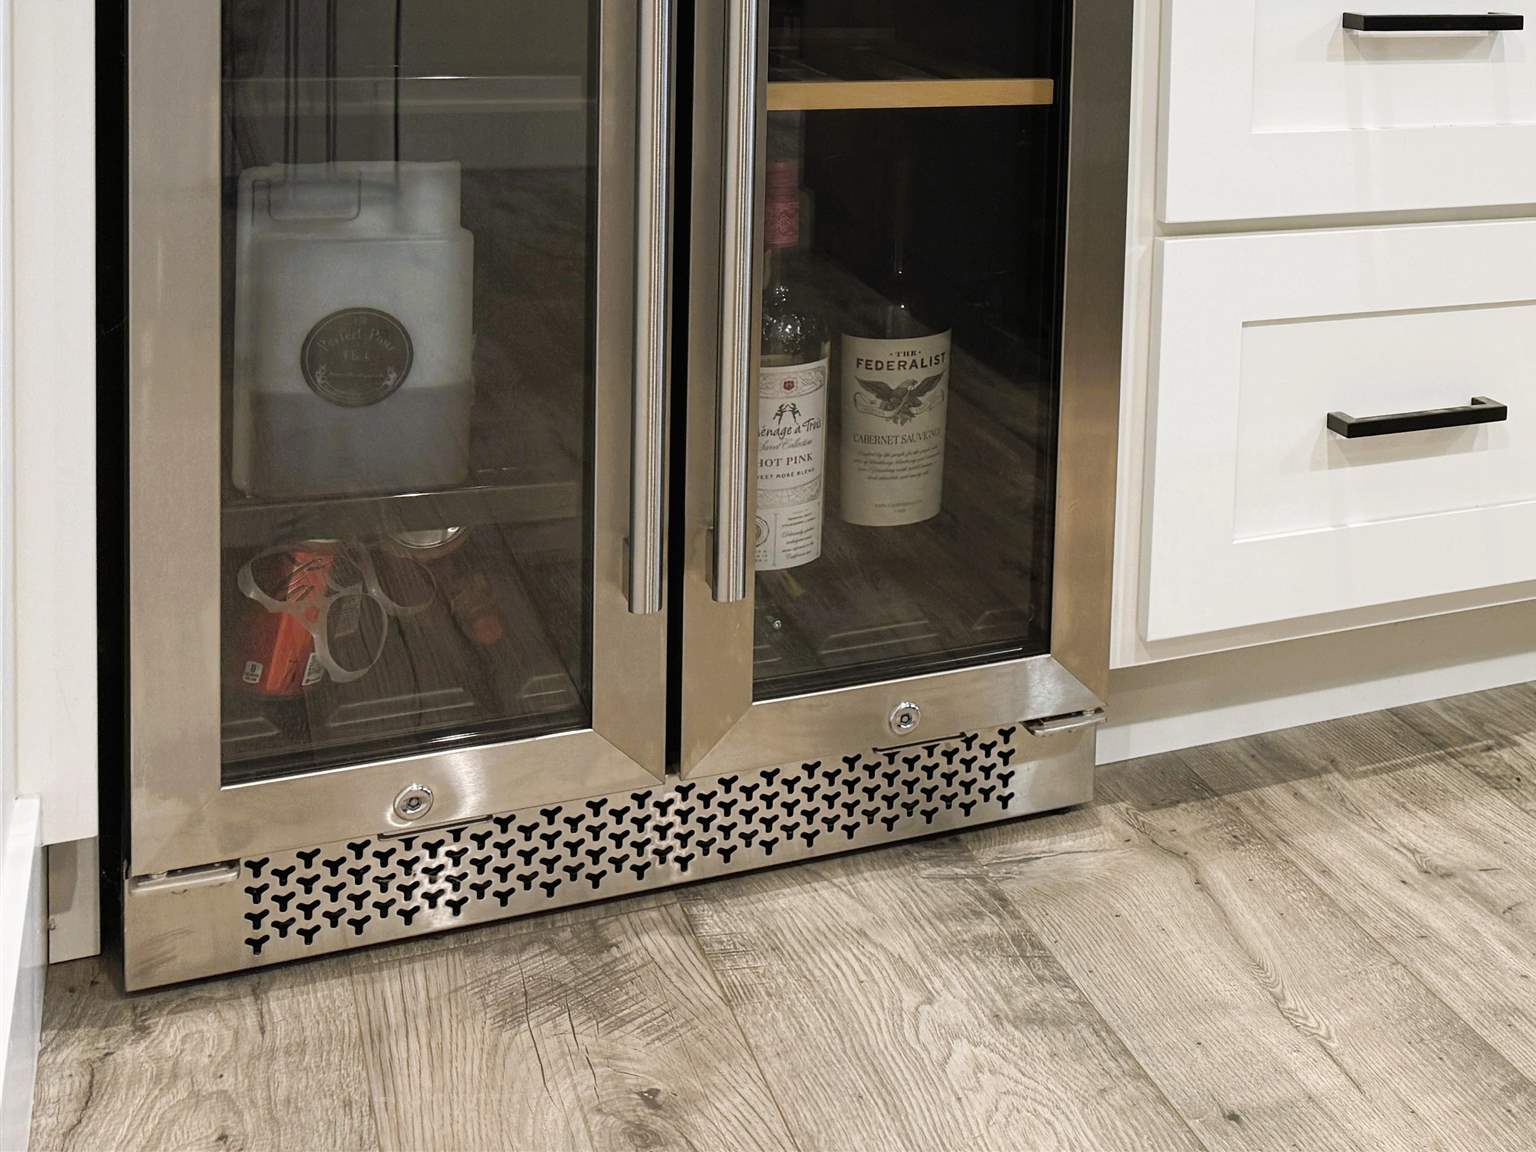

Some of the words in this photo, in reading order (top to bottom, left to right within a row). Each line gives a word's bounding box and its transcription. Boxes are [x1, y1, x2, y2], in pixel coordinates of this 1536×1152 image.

[856, 351, 947, 371] FEDERALIST
[852, 432, 899, 446] CABERNET
[786, 452, 813, 466] PINK
